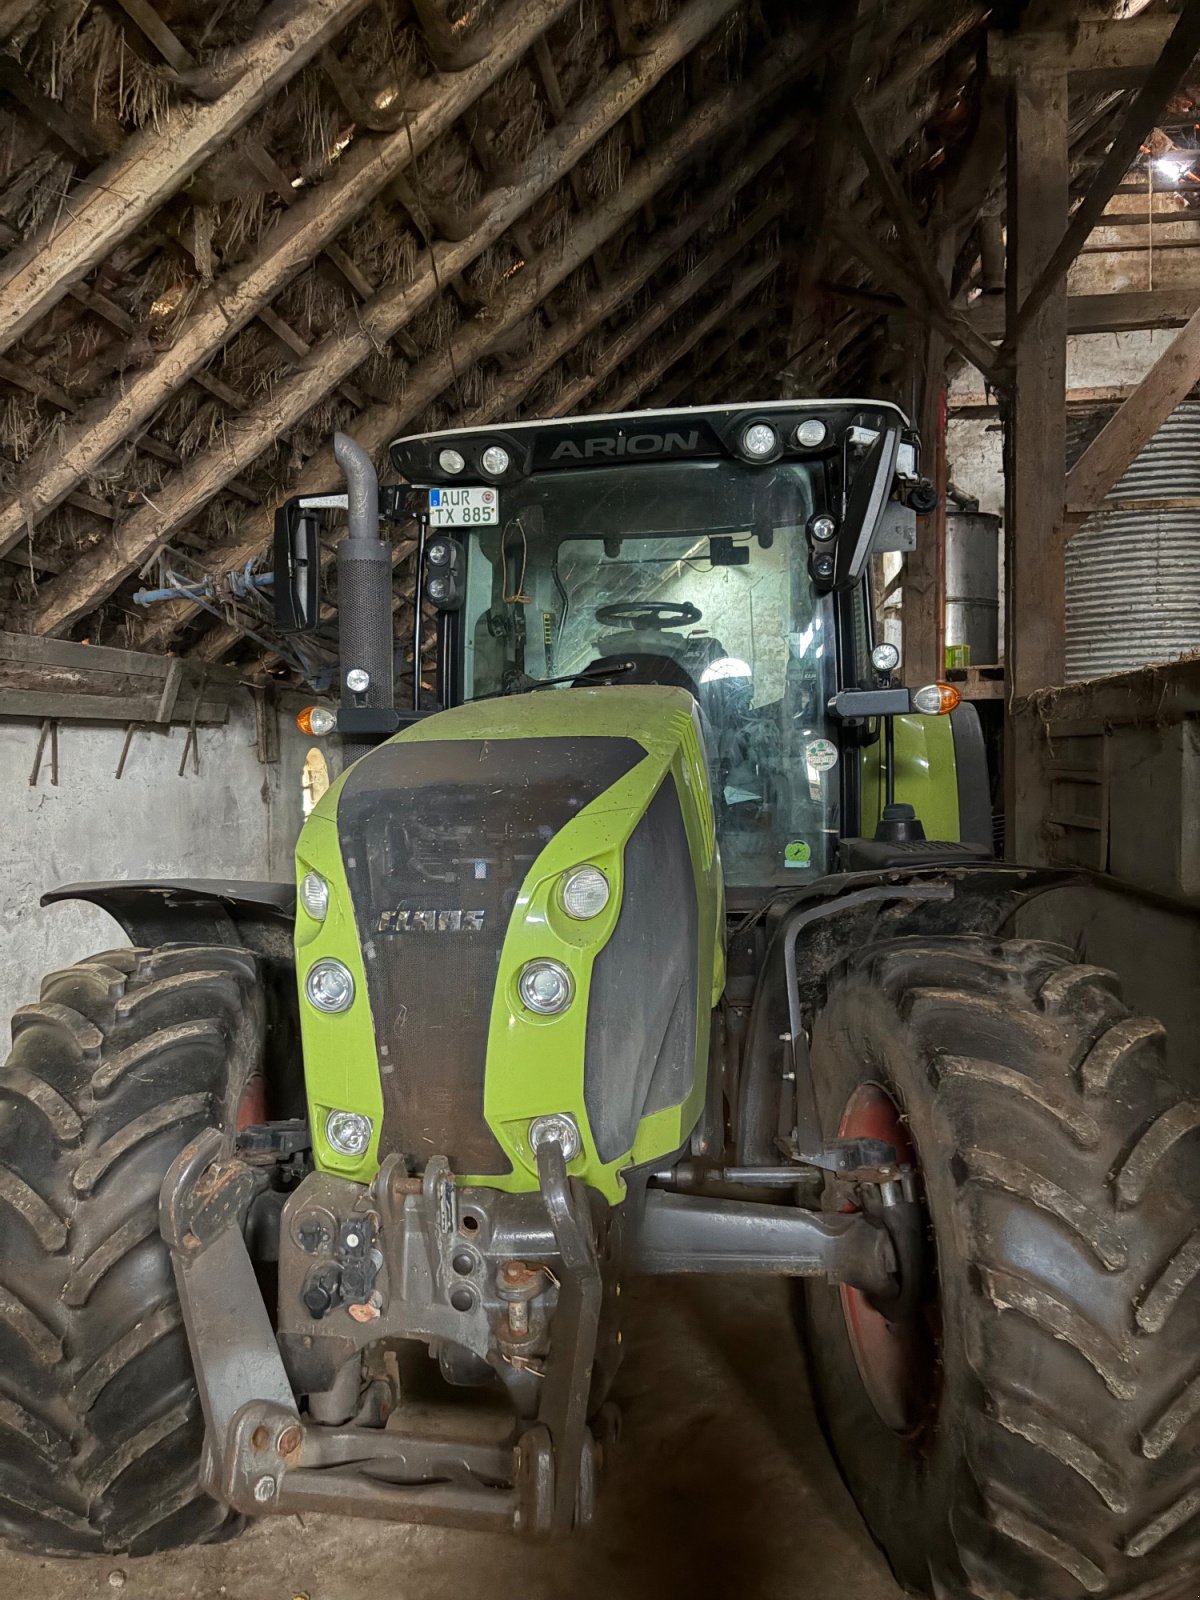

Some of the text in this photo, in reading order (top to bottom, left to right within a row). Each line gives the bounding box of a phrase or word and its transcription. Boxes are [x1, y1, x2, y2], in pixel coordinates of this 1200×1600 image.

[550, 430, 699, 460] ARION
[441, 490, 470, 506] AUR
[435, 506, 491, 523] TX 885
